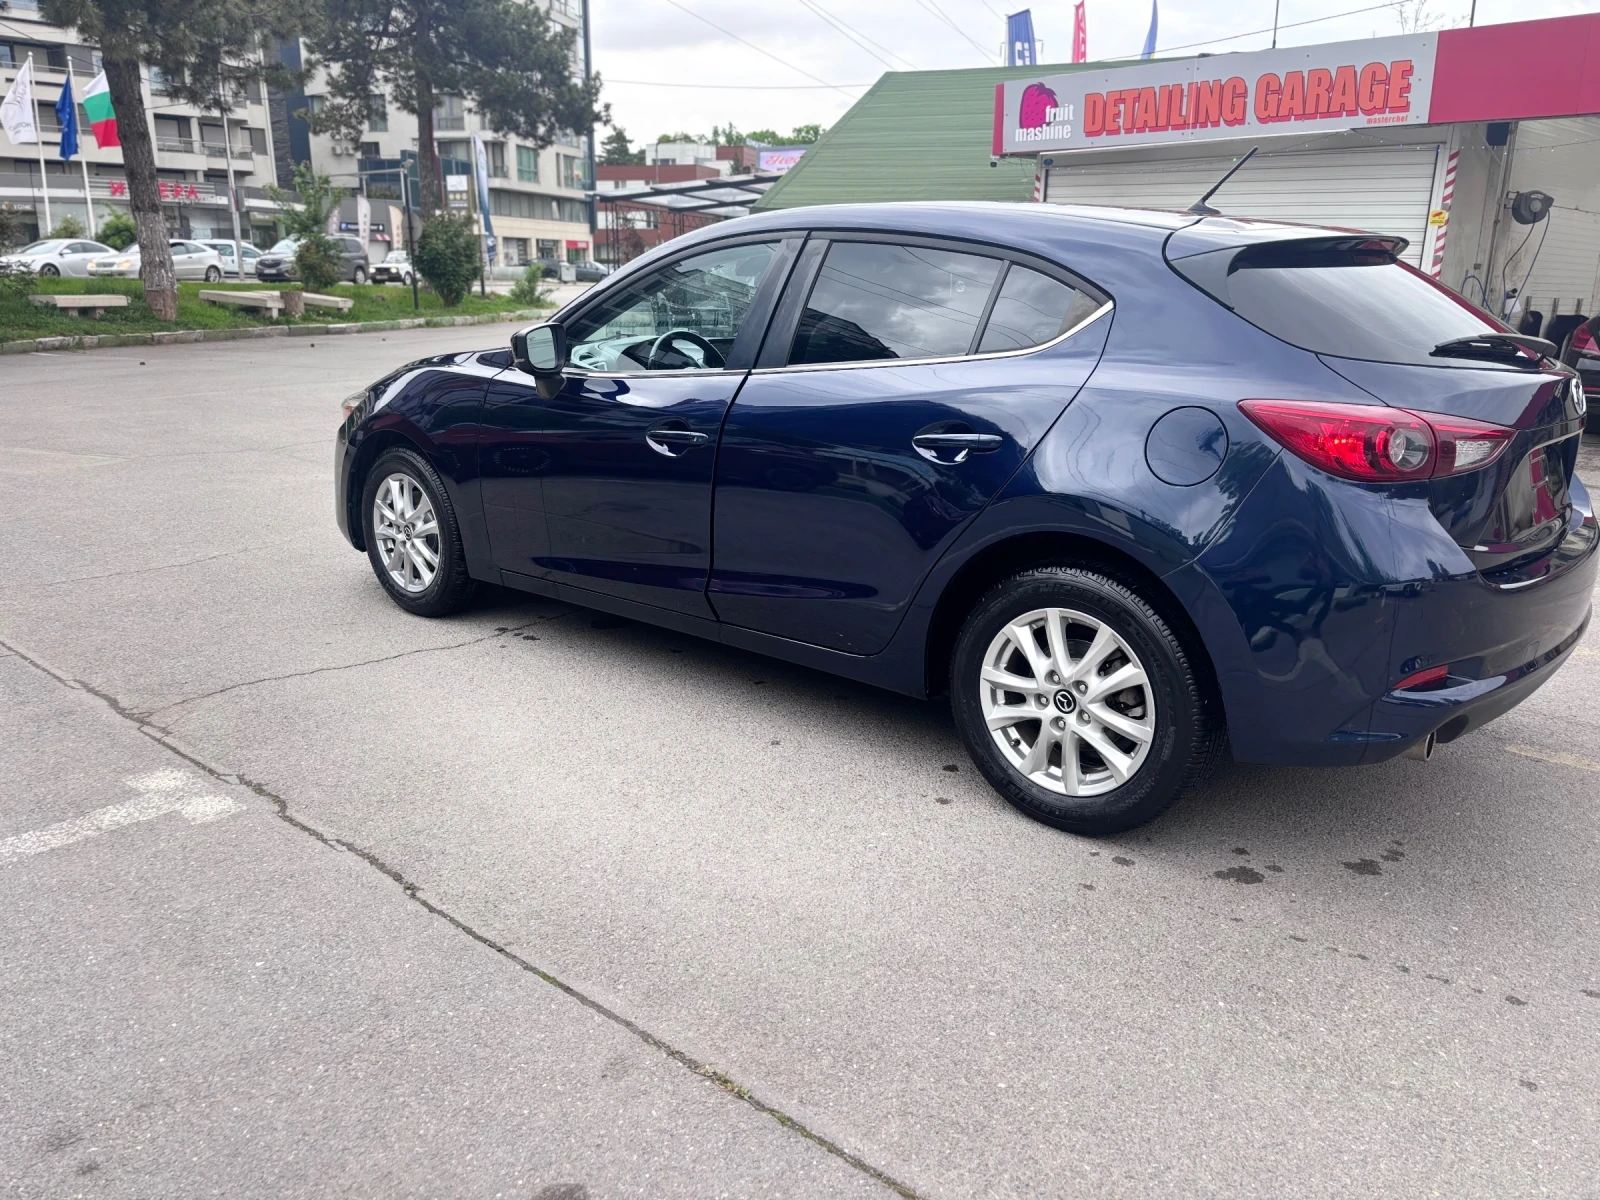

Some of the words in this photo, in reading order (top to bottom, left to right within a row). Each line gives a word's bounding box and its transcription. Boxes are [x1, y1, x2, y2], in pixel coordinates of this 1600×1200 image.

[1084, 77, 1248, 137] DETAILING
[1254, 59, 1414, 124] GARAGE
[1045, 104, 1074, 123] fruit
[1366, 115, 1408, 125] masterchef
[1015, 124, 1072, 142] mashine
